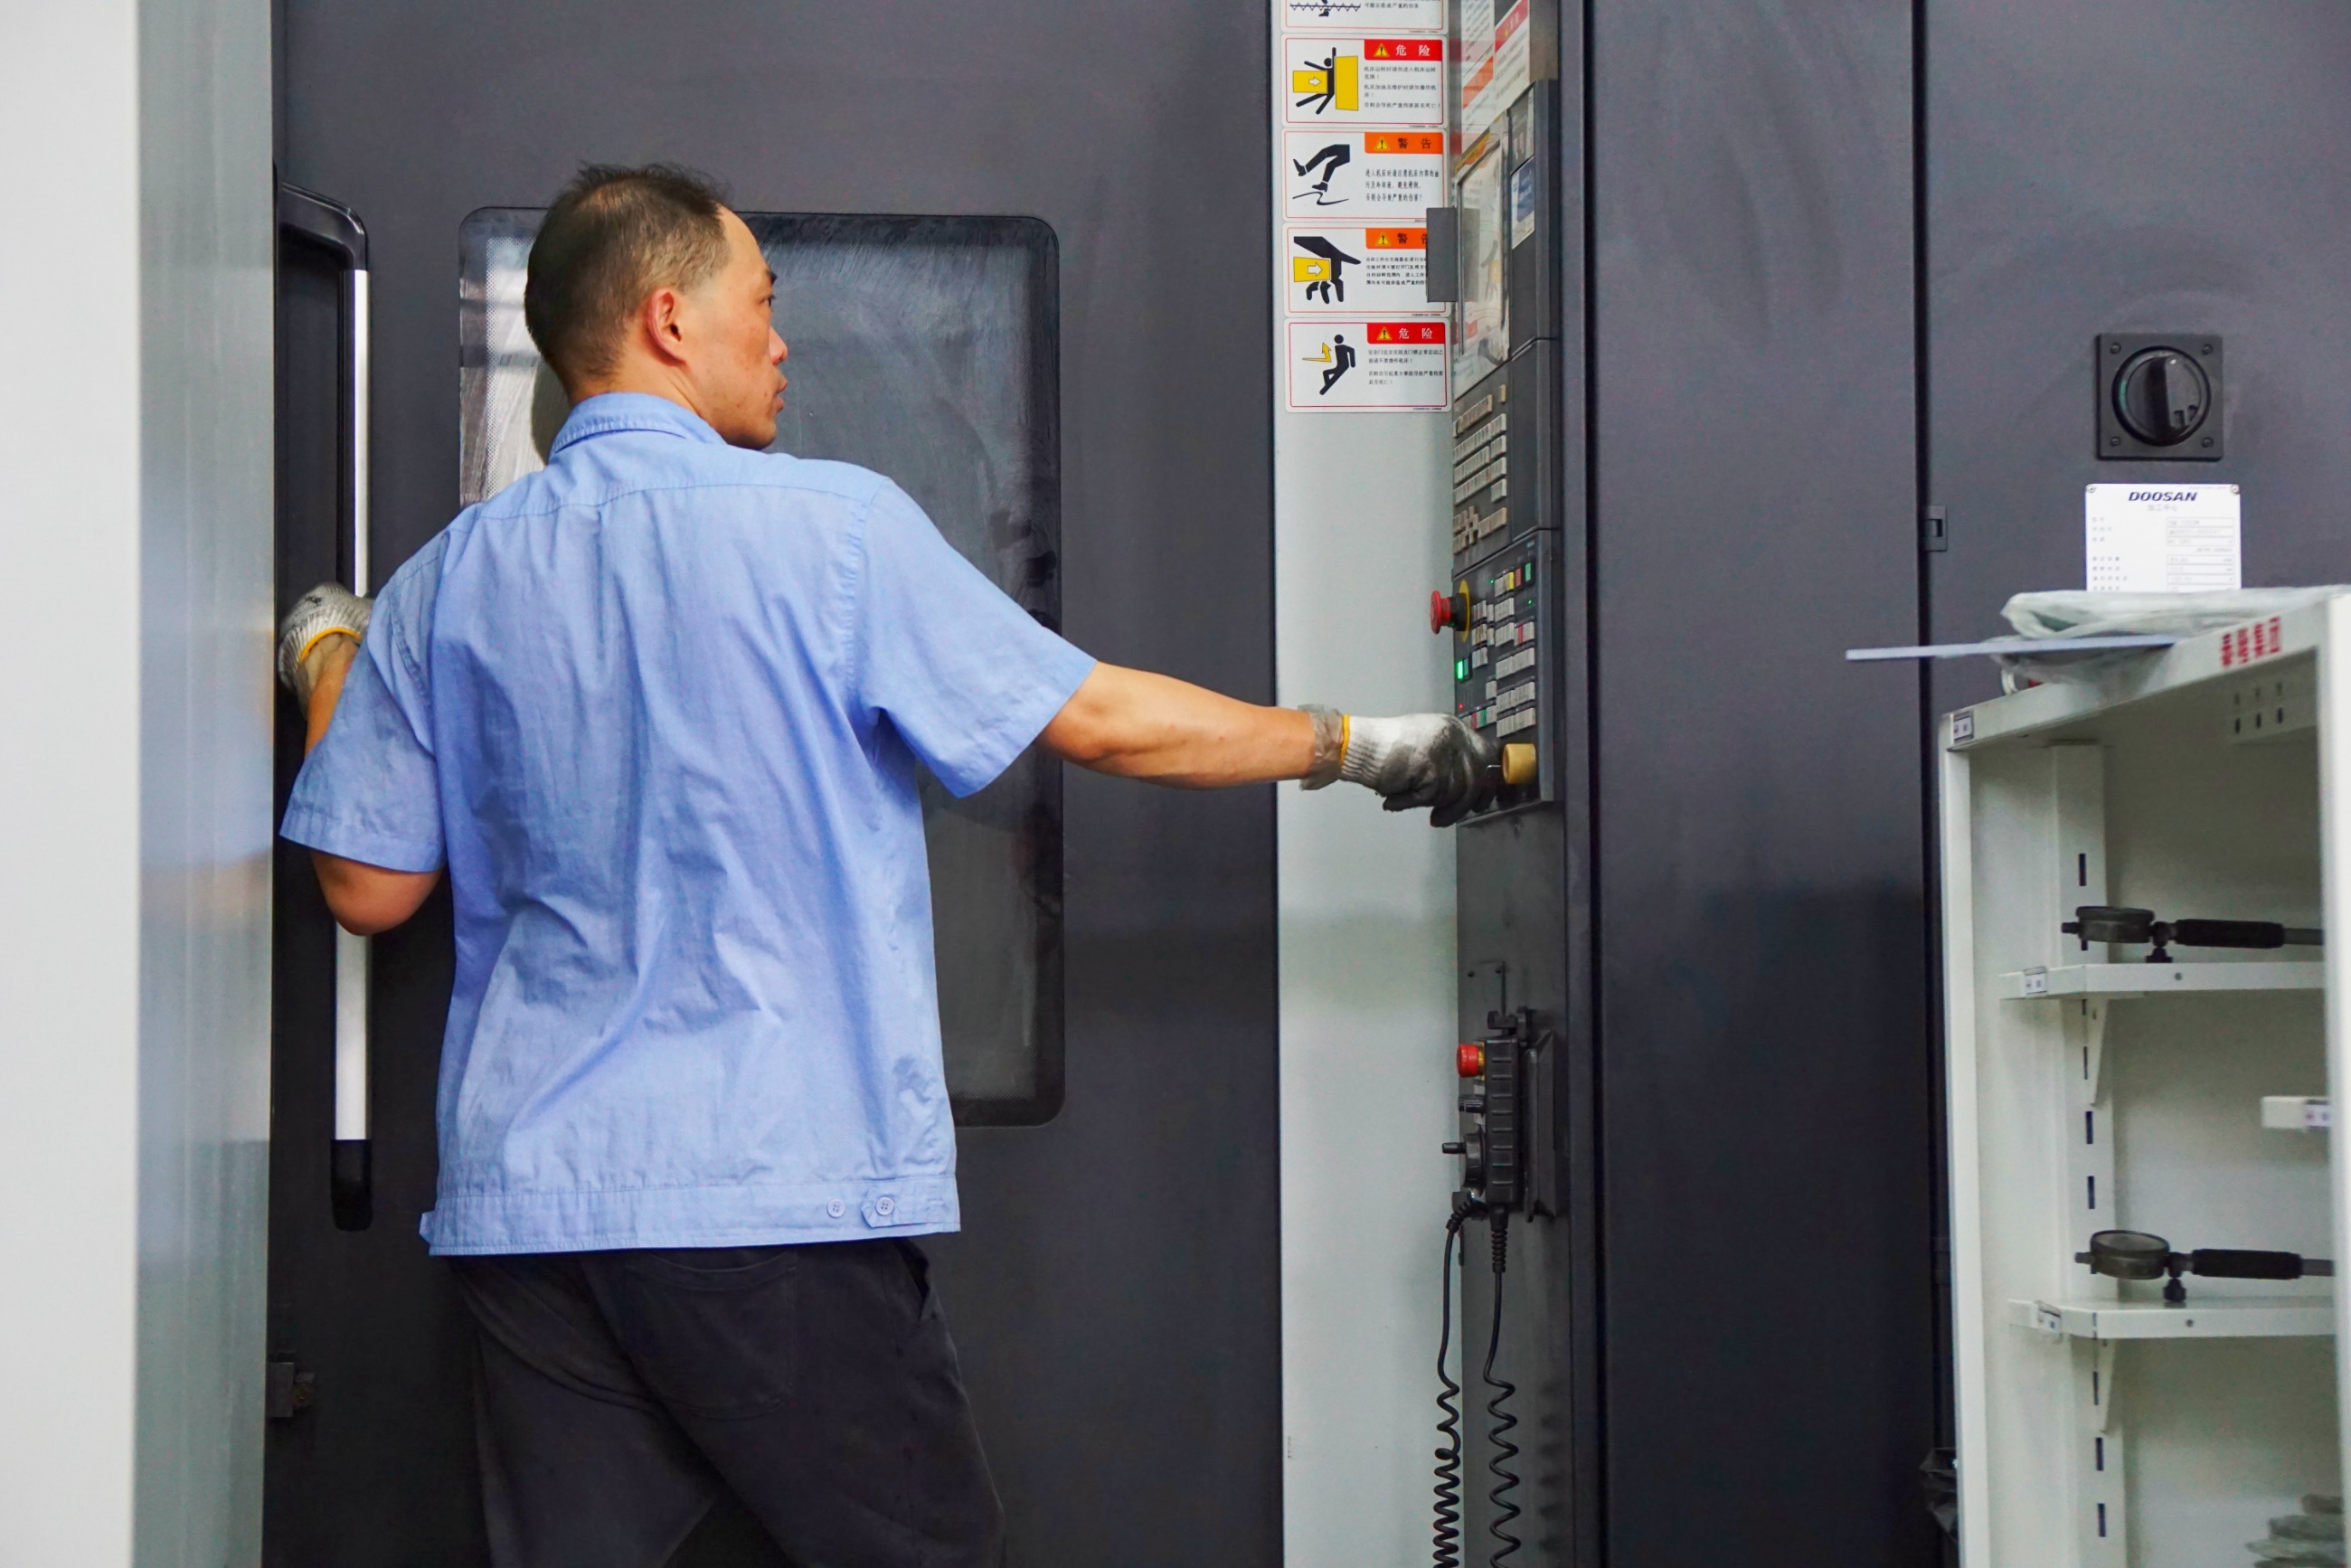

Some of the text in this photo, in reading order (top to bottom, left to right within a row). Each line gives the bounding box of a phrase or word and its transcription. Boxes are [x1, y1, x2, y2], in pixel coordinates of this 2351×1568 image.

[1395, 44, 1430, 56] 危险
[1397, 137, 1432, 149] 警告
[1399, 327, 1433, 339] 危险
[2128, 491, 2198, 502] DOOSAN
